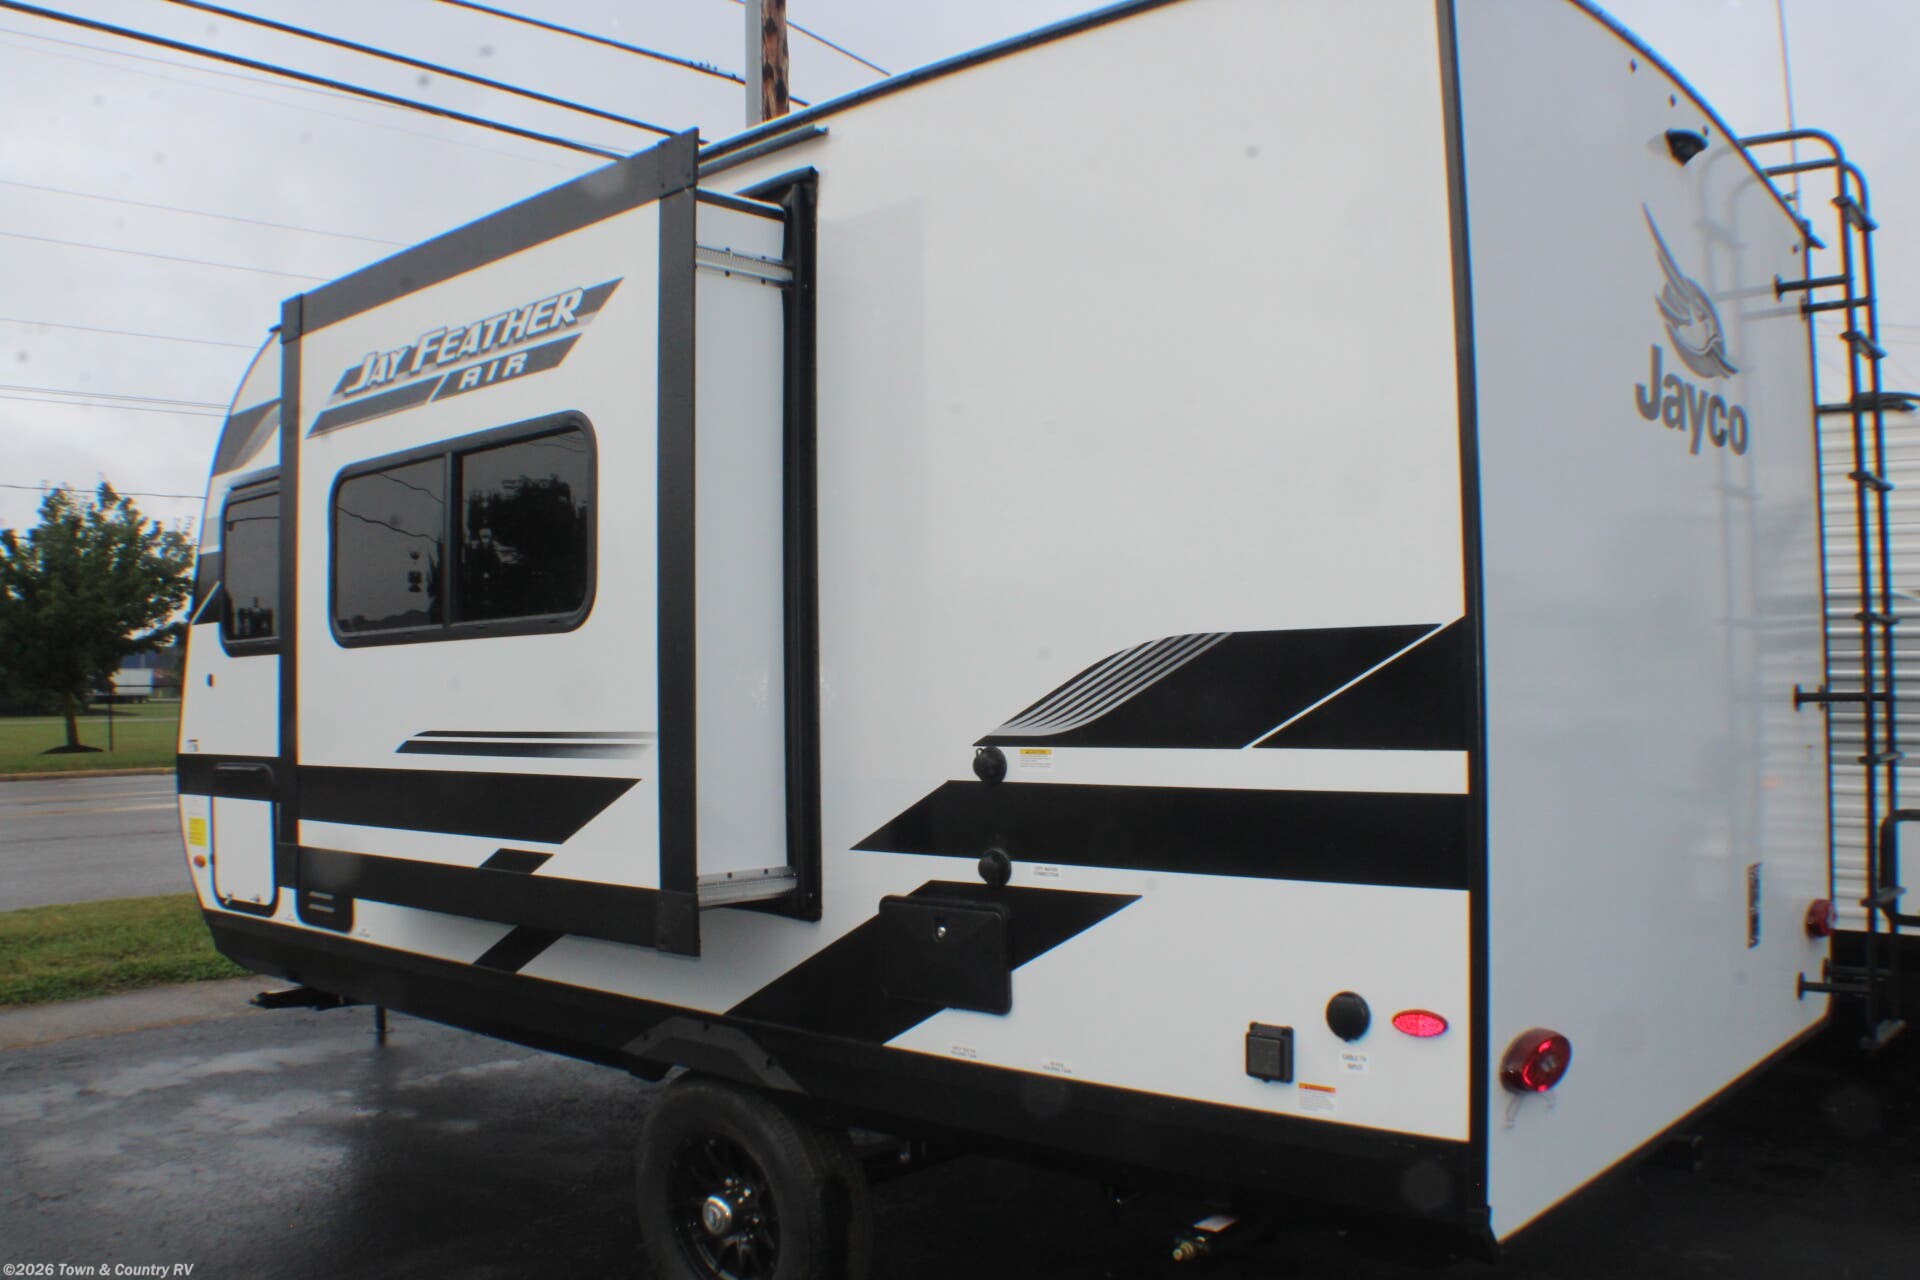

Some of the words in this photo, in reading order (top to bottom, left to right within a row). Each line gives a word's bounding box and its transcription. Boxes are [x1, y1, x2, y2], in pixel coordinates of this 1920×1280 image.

[344, 346, 411, 395] JAY
[410, 287, 584, 374] FEATHER
[458, 352, 528, 390] AIR
[1635, 343, 1748, 456] Jayco
